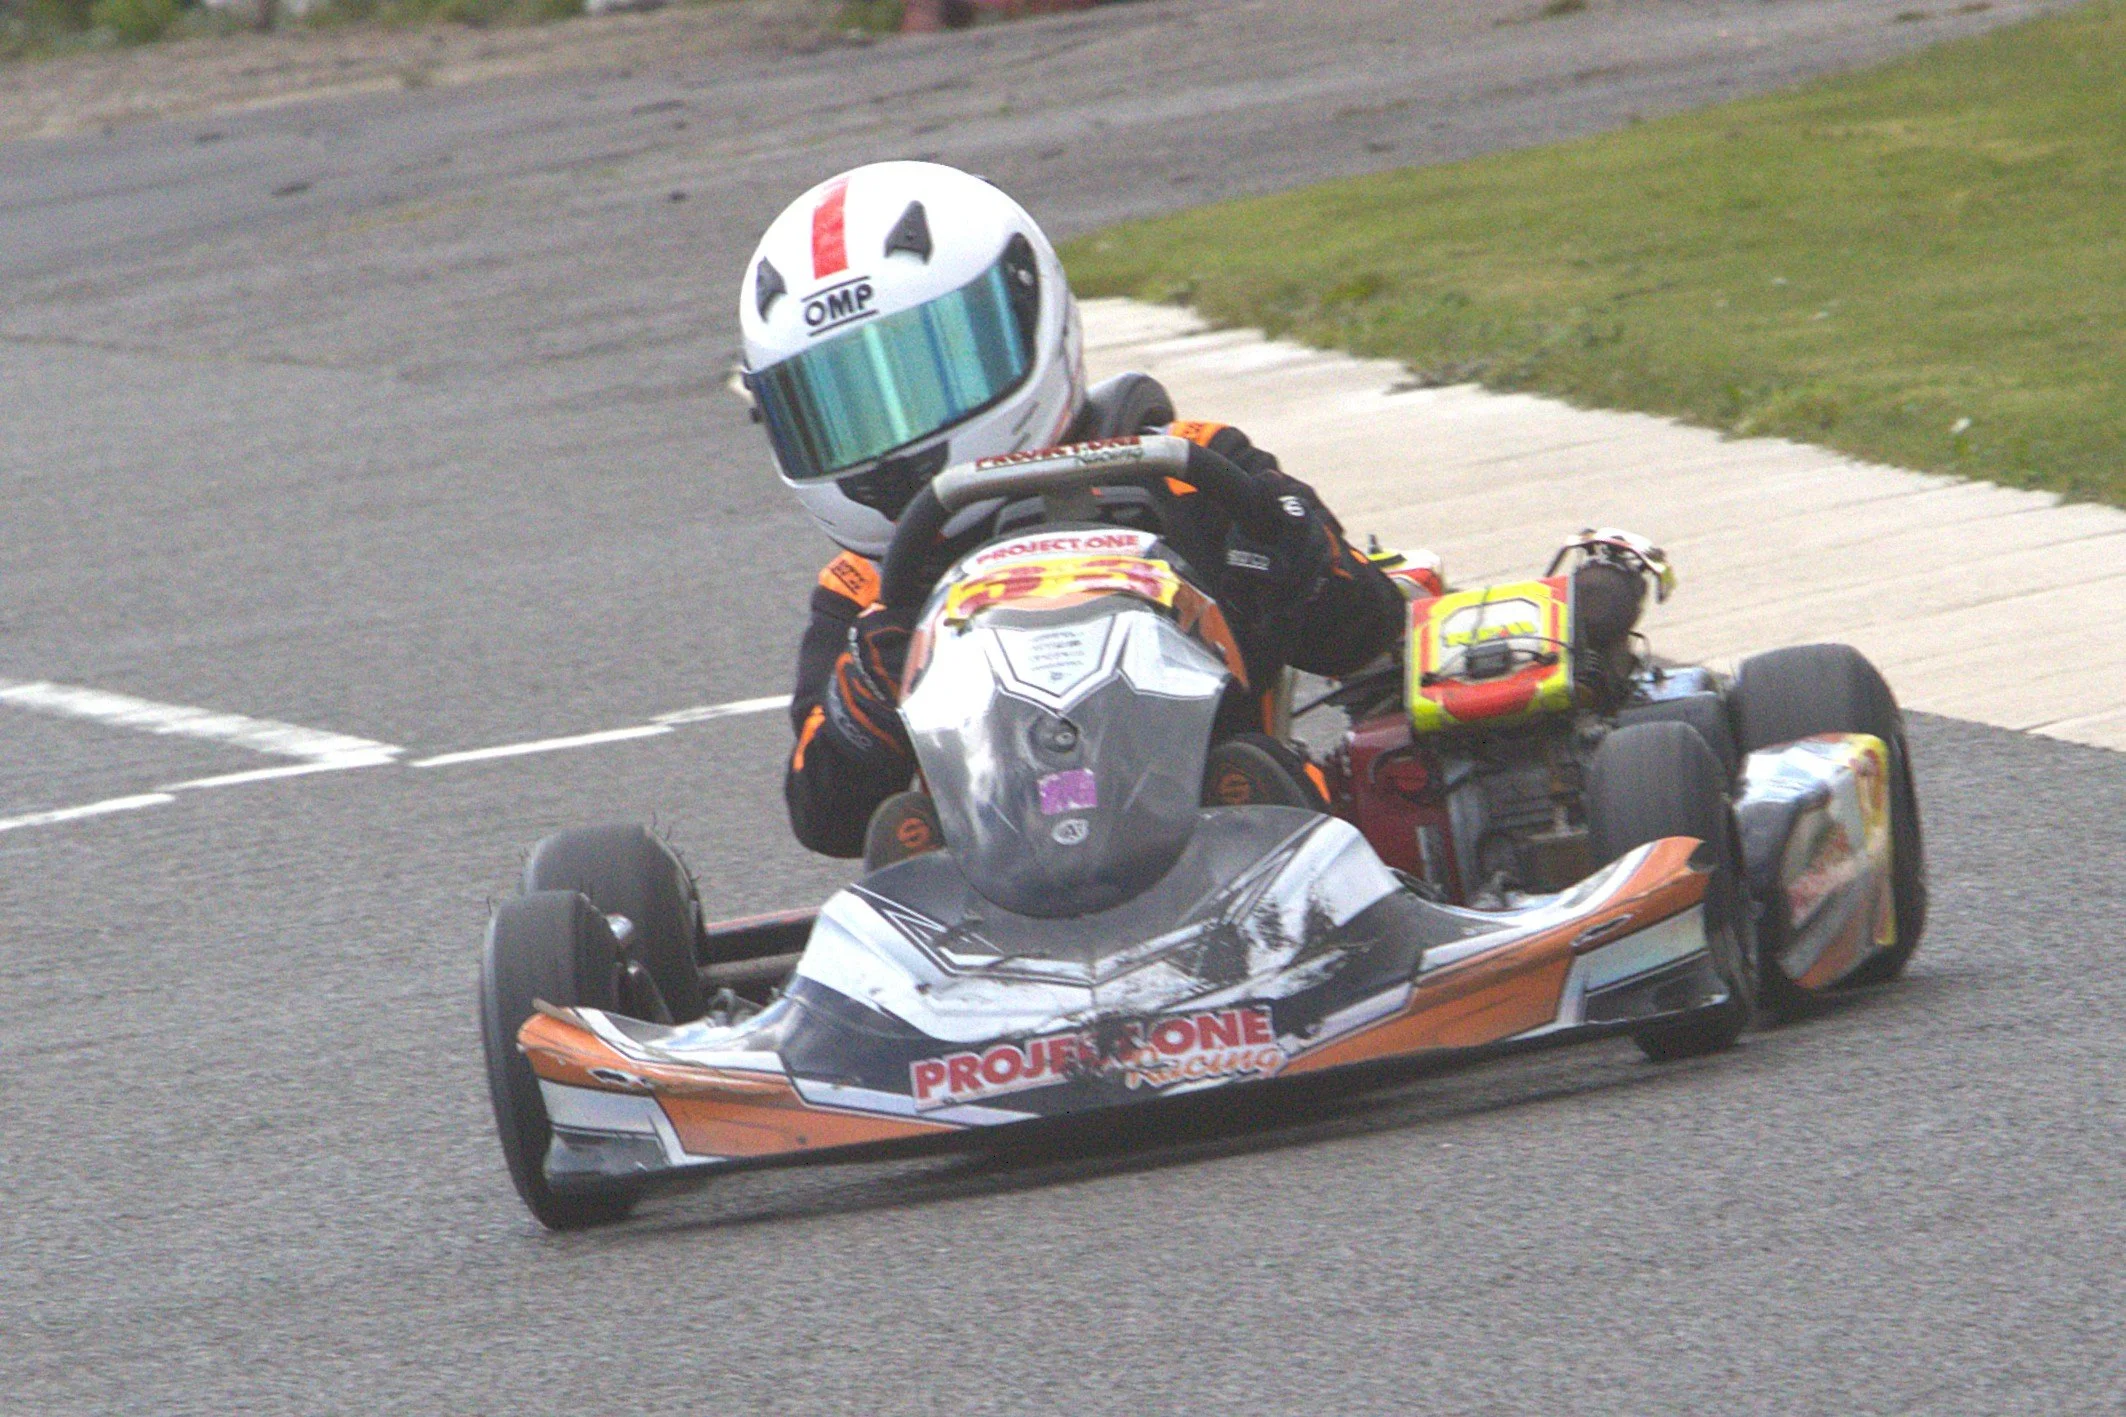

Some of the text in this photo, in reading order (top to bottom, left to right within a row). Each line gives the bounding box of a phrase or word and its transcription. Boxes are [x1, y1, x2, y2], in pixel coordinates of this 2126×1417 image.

[804, 283, 874, 326] OMP
[976, 534, 1140, 565] PROJECT ONE
[1149, 1008, 1273, 1056] ONE
